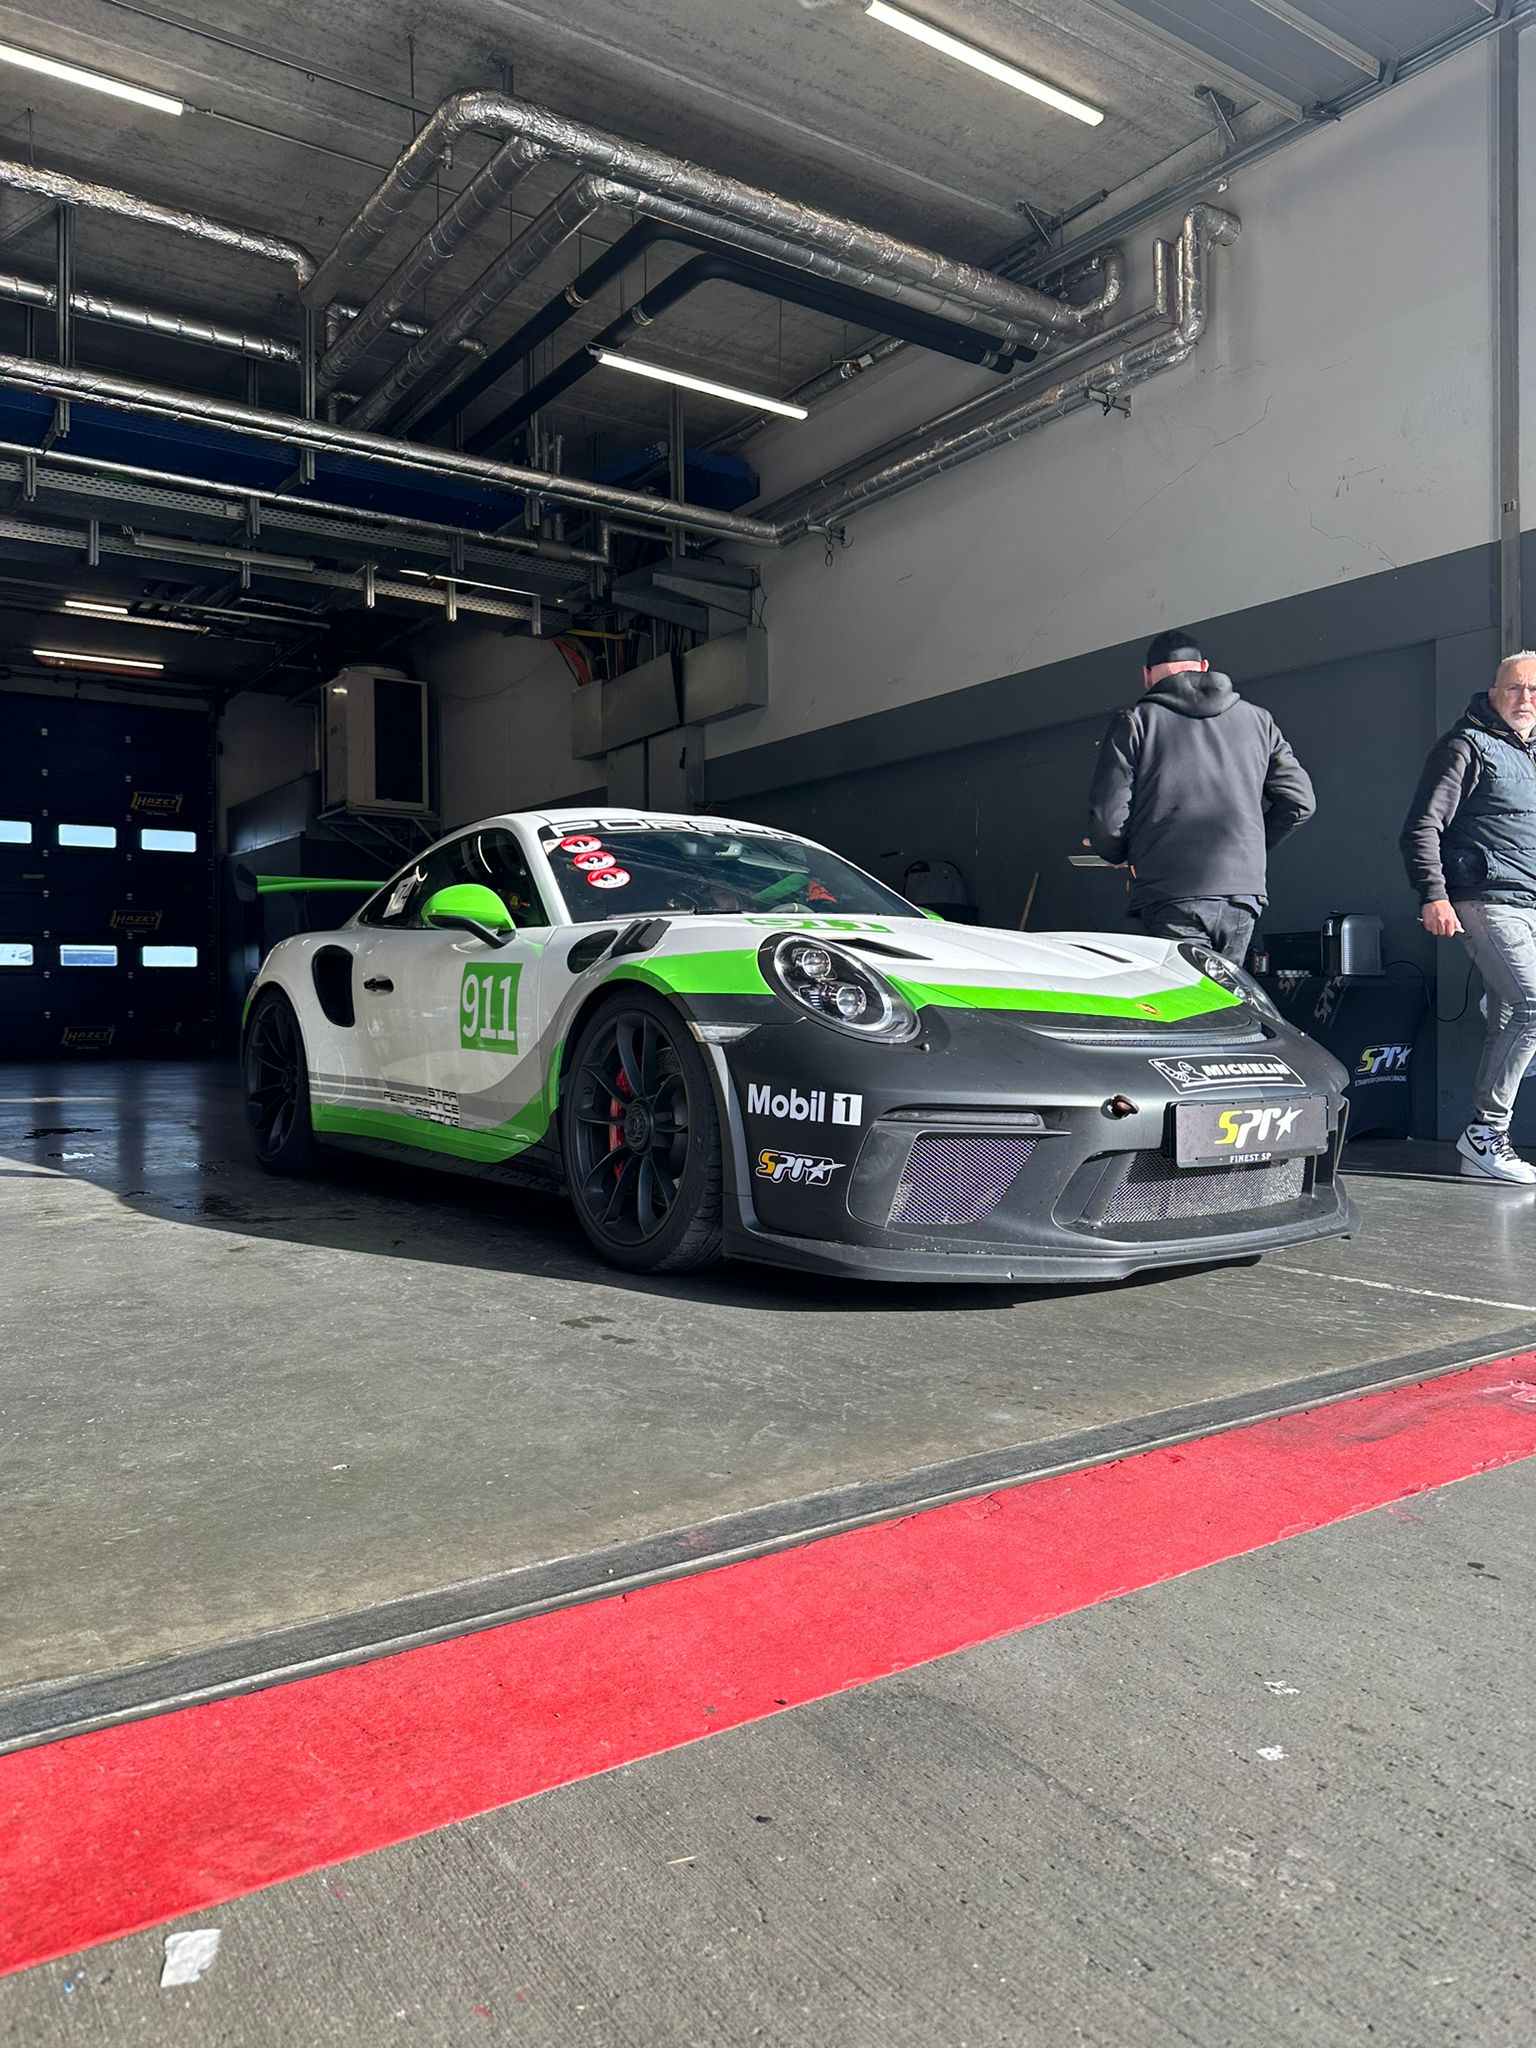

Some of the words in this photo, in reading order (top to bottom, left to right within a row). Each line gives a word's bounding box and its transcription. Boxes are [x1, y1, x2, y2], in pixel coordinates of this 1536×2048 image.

[462, 973, 515, 1041] 911
[1201, 1063, 1291, 1076] MICHELIN
[428, 1087, 457, 1101] STAR
[747, 1083, 826, 1122] Mobil
[1229, 1153, 1259, 1163] FINEST
